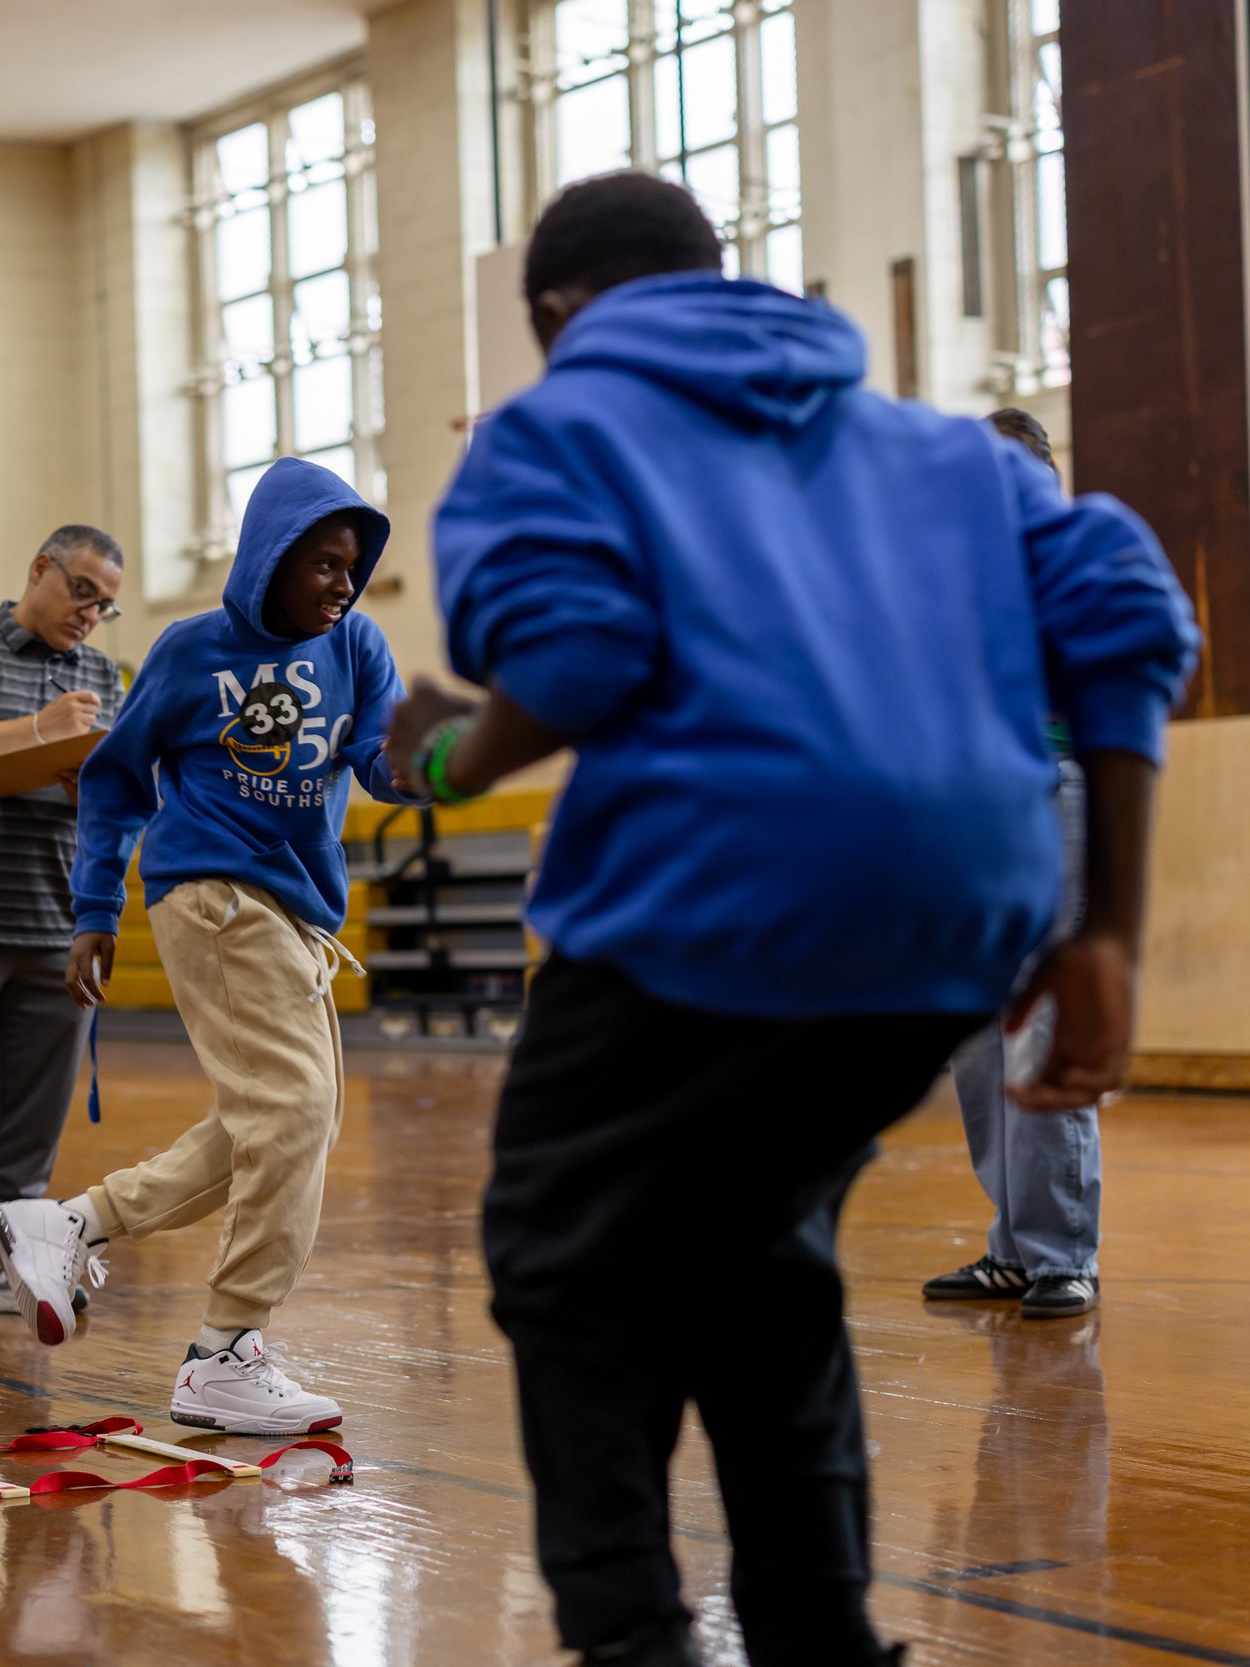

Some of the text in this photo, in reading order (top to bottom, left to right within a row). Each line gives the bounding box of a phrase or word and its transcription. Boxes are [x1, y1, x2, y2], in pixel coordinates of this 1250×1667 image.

[212, 660, 322, 718] MS
[245, 693, 299, 735] 33
[222, 769, 324, 794] PRIDE OF
